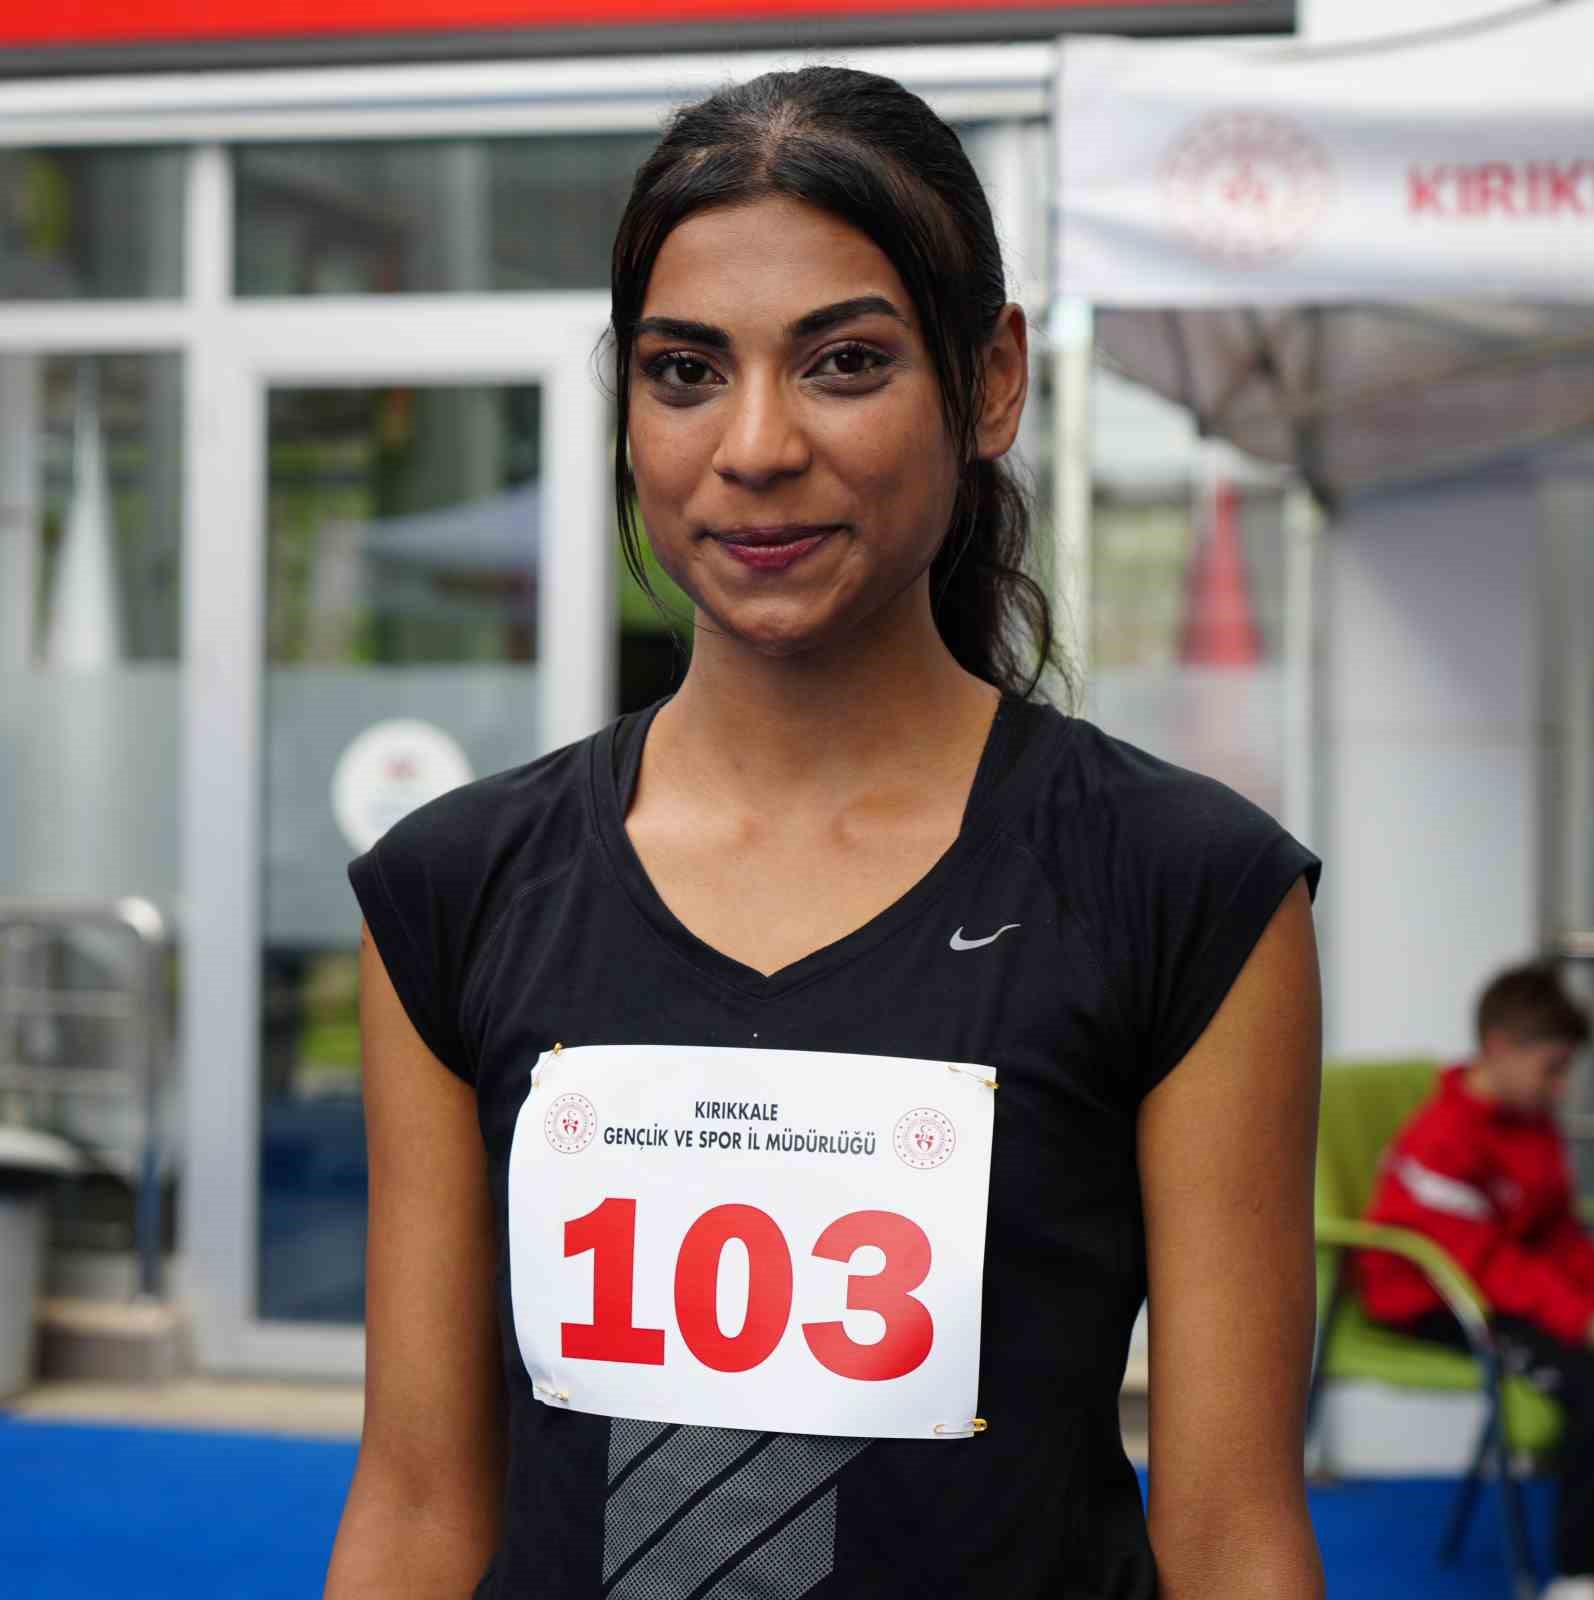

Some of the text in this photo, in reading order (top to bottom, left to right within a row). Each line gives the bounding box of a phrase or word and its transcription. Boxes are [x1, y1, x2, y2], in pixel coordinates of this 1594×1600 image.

[695, 1101, 778, 1121] KIRIKKALE
[604, 1123, 669, 1150] GENÇLİK
[674, 1130, 694, 1147] VE
[699, 1131, 742, 1150] SPOR
[748, 1126, 760, 1150] İL
[766, 1128, 876, 1155] MÜDÜRLÜĞÜ
[561, 1197, 934, 1382] 103
